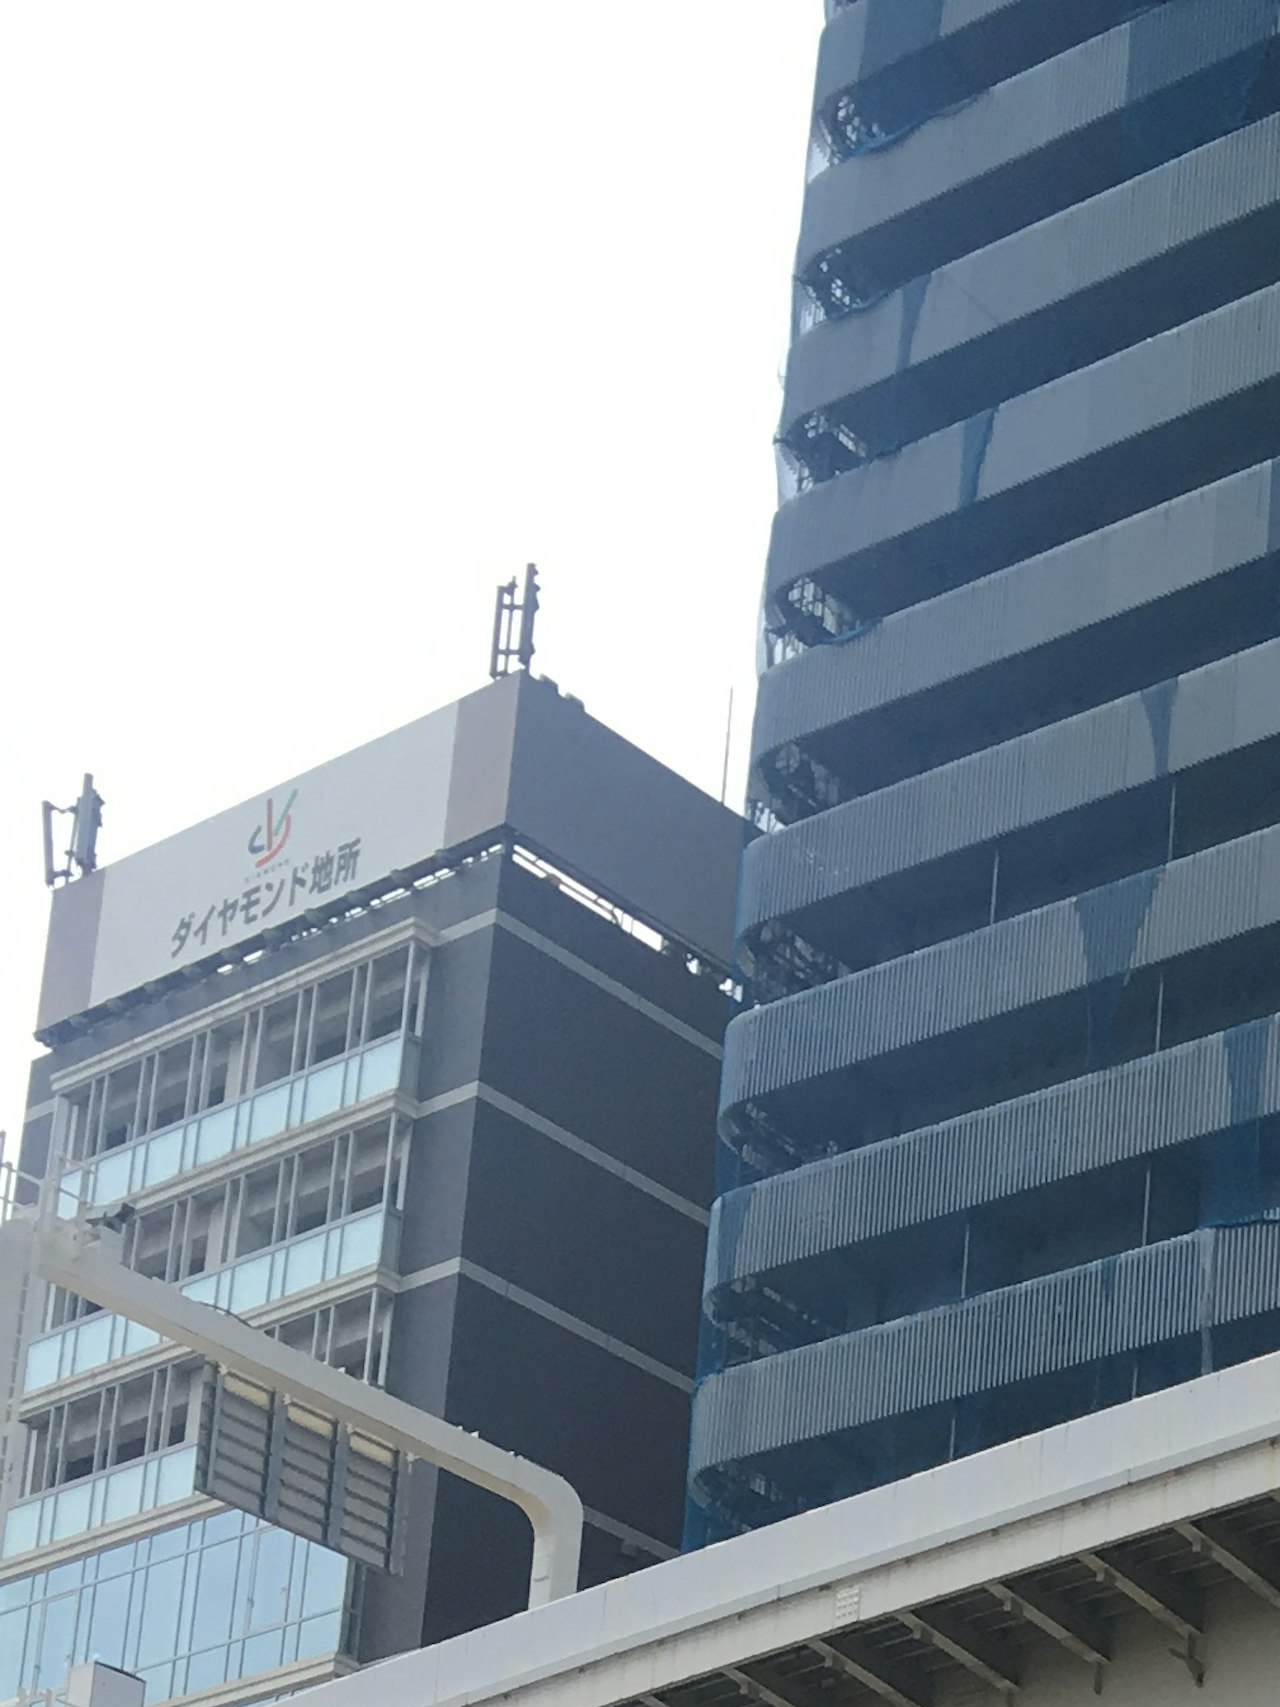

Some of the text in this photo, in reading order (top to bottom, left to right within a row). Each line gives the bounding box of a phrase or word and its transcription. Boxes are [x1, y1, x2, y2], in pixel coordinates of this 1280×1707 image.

[171, 837, 361, 958] ダイヤモンド地所
